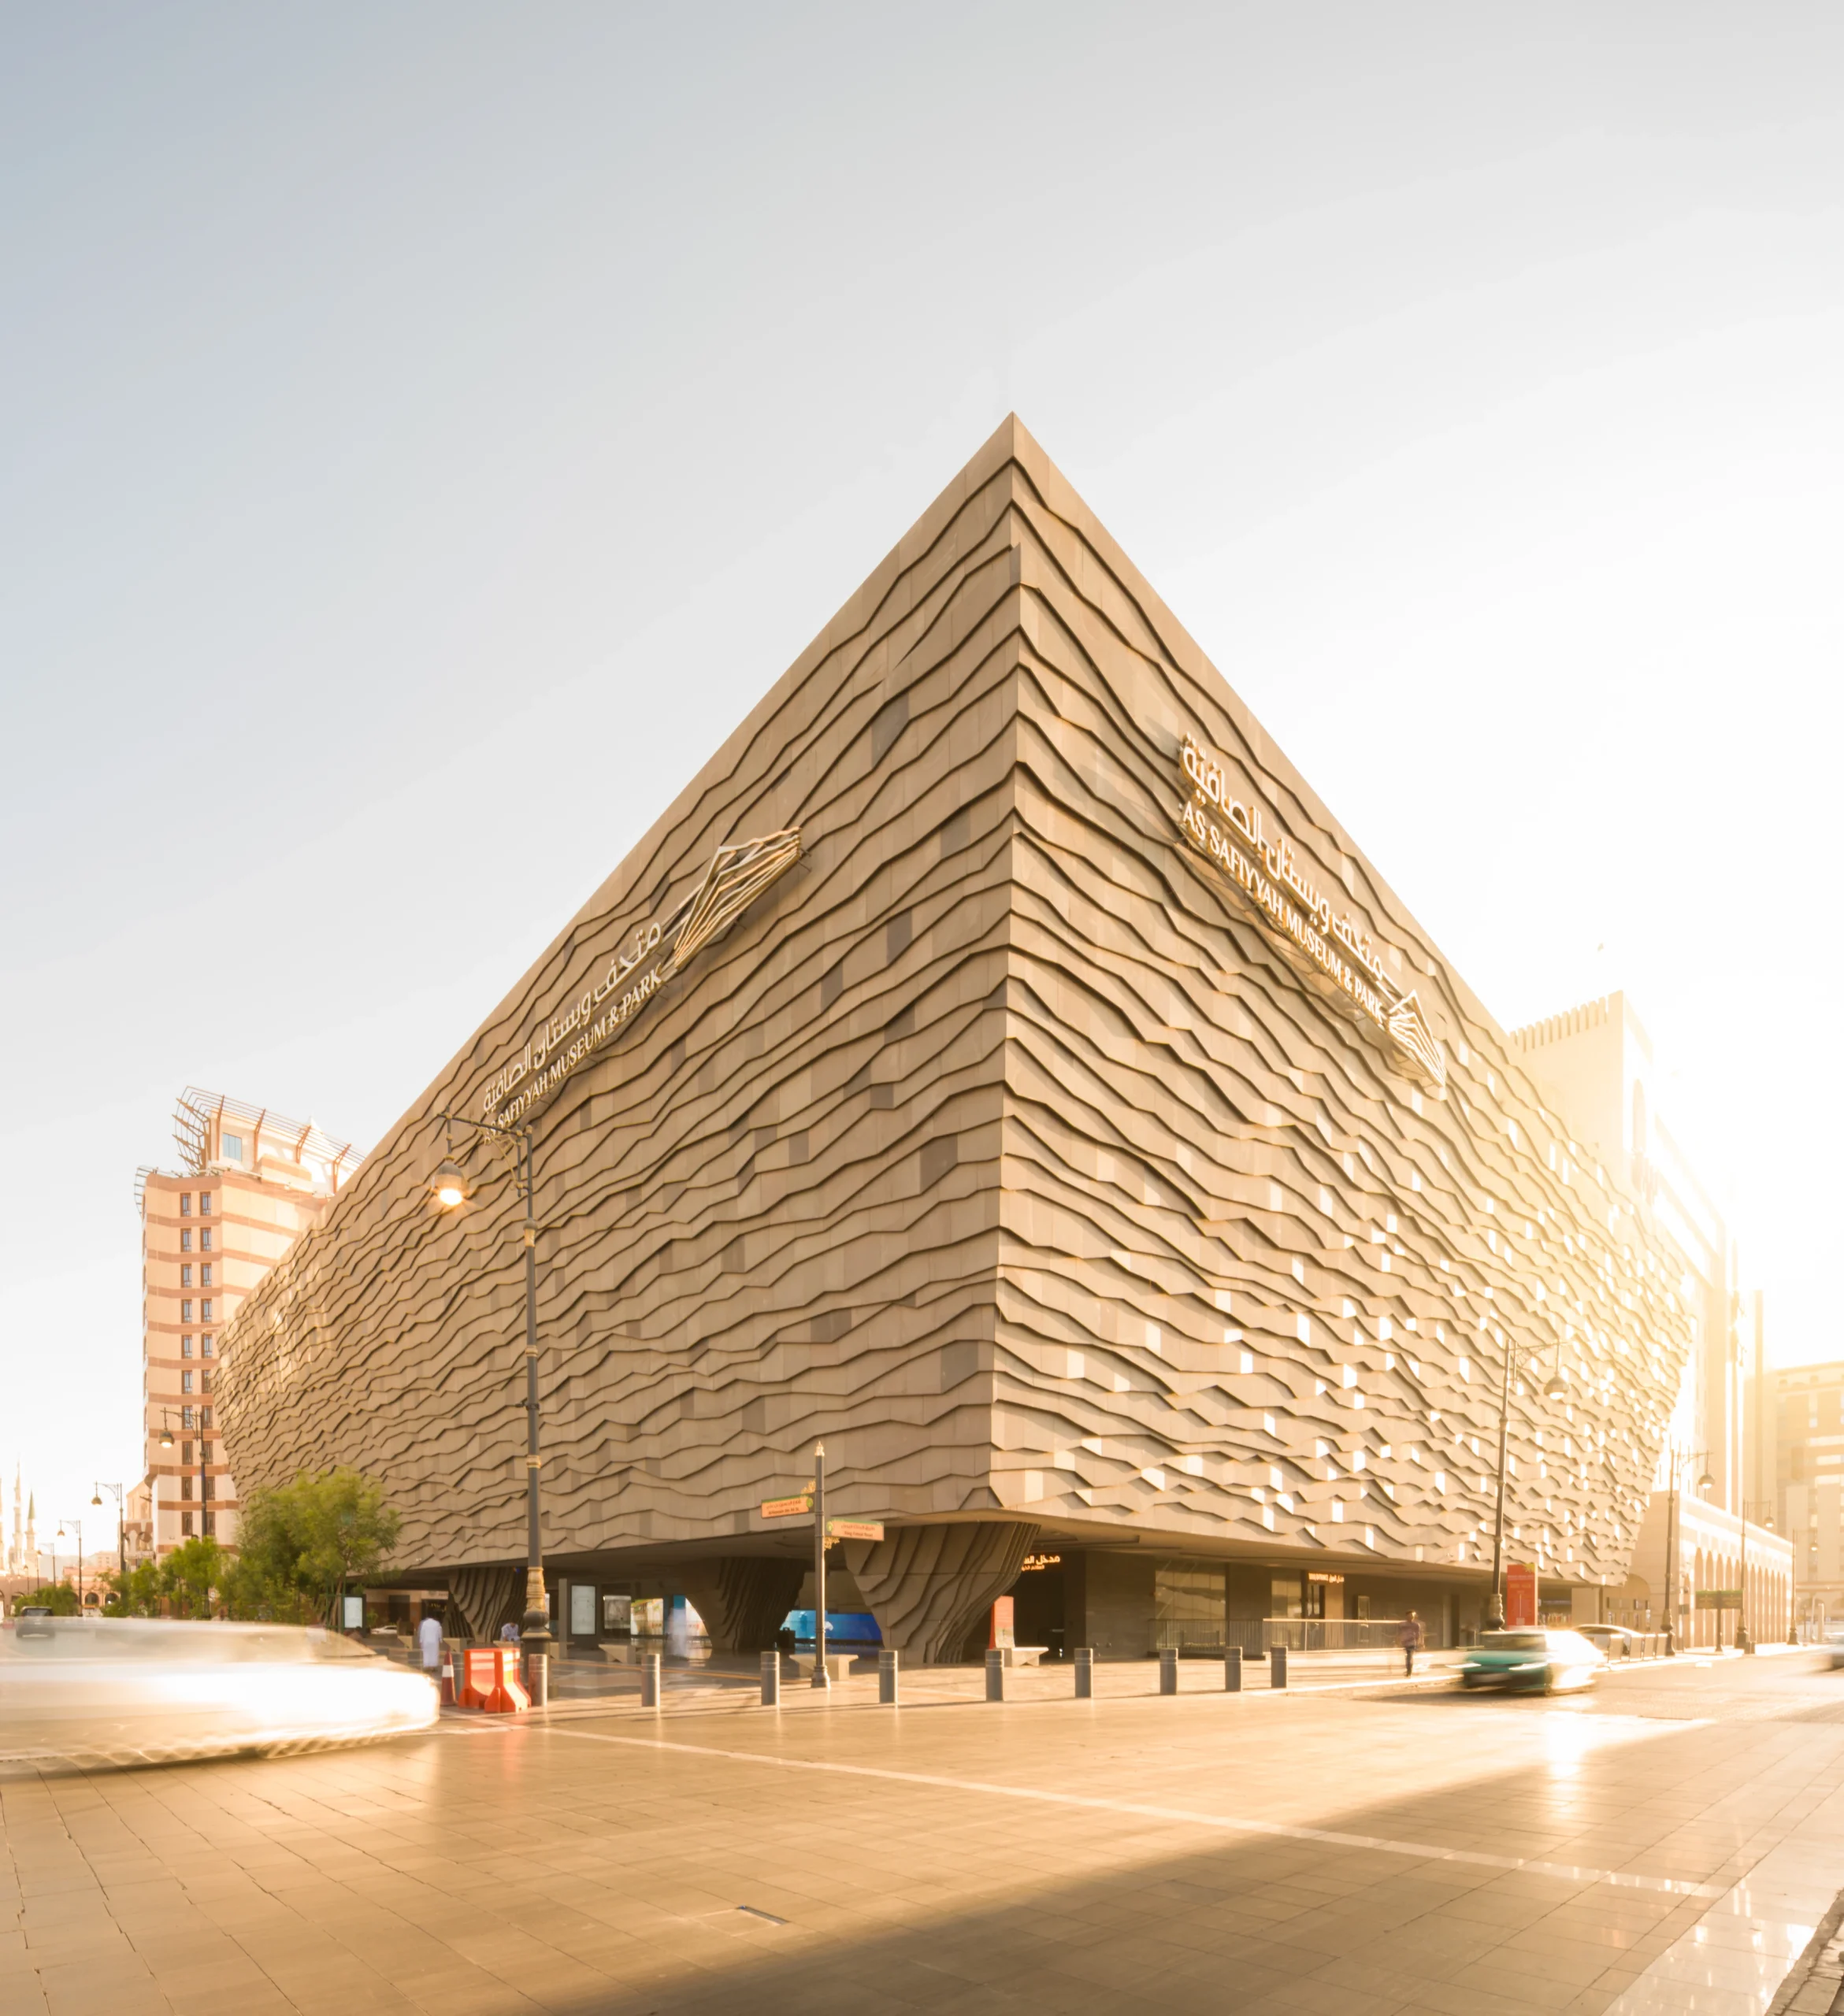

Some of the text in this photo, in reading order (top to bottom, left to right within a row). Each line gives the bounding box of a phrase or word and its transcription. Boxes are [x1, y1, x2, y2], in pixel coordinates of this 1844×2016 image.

[1182, 801, 1386, 1025] AS SAFIYYAH MUSEUM & PARK
[497, 1072, 548, 1129] SAFIYYAH
[551, 1016, 607, 1087] MUSEUM
[609, 1005, 620, 1028] &
[621, 962, 662, 1017] PARK
